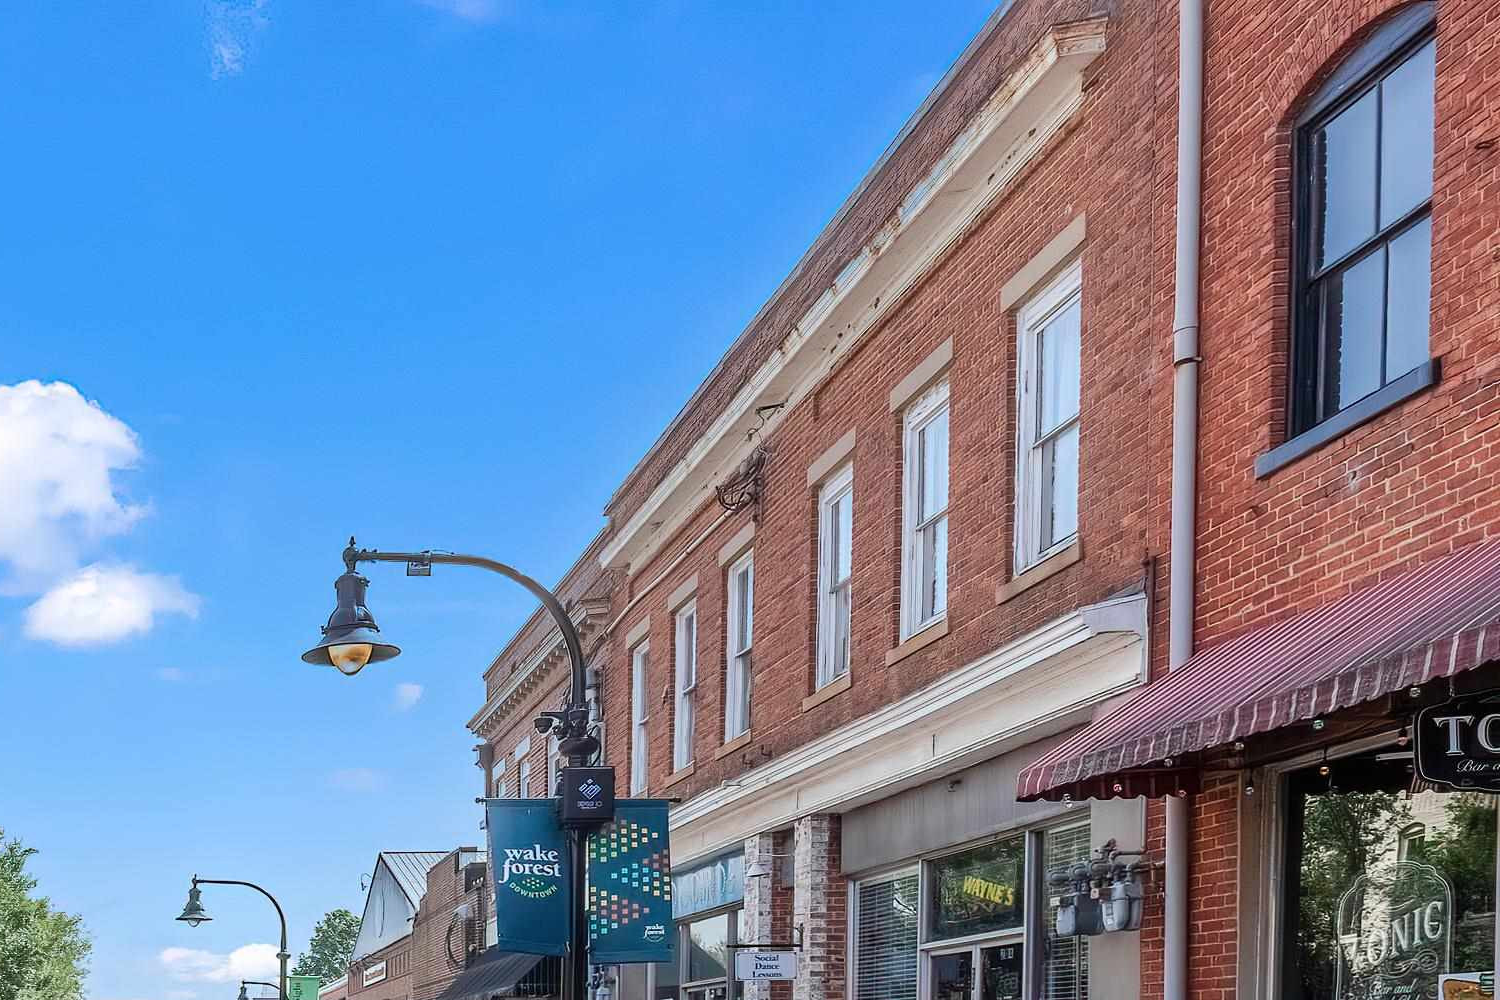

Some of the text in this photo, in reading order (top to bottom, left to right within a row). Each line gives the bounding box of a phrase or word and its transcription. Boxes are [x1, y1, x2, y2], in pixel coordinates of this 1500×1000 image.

[504, 844, 558, 861] wake
[499, 858, 561, 883] forest
[509, 882, 557, 898] DOWNTOWN
[963, 875, 1012, 906] WAYNE'S
[755, 962, 780, 970] Dance
